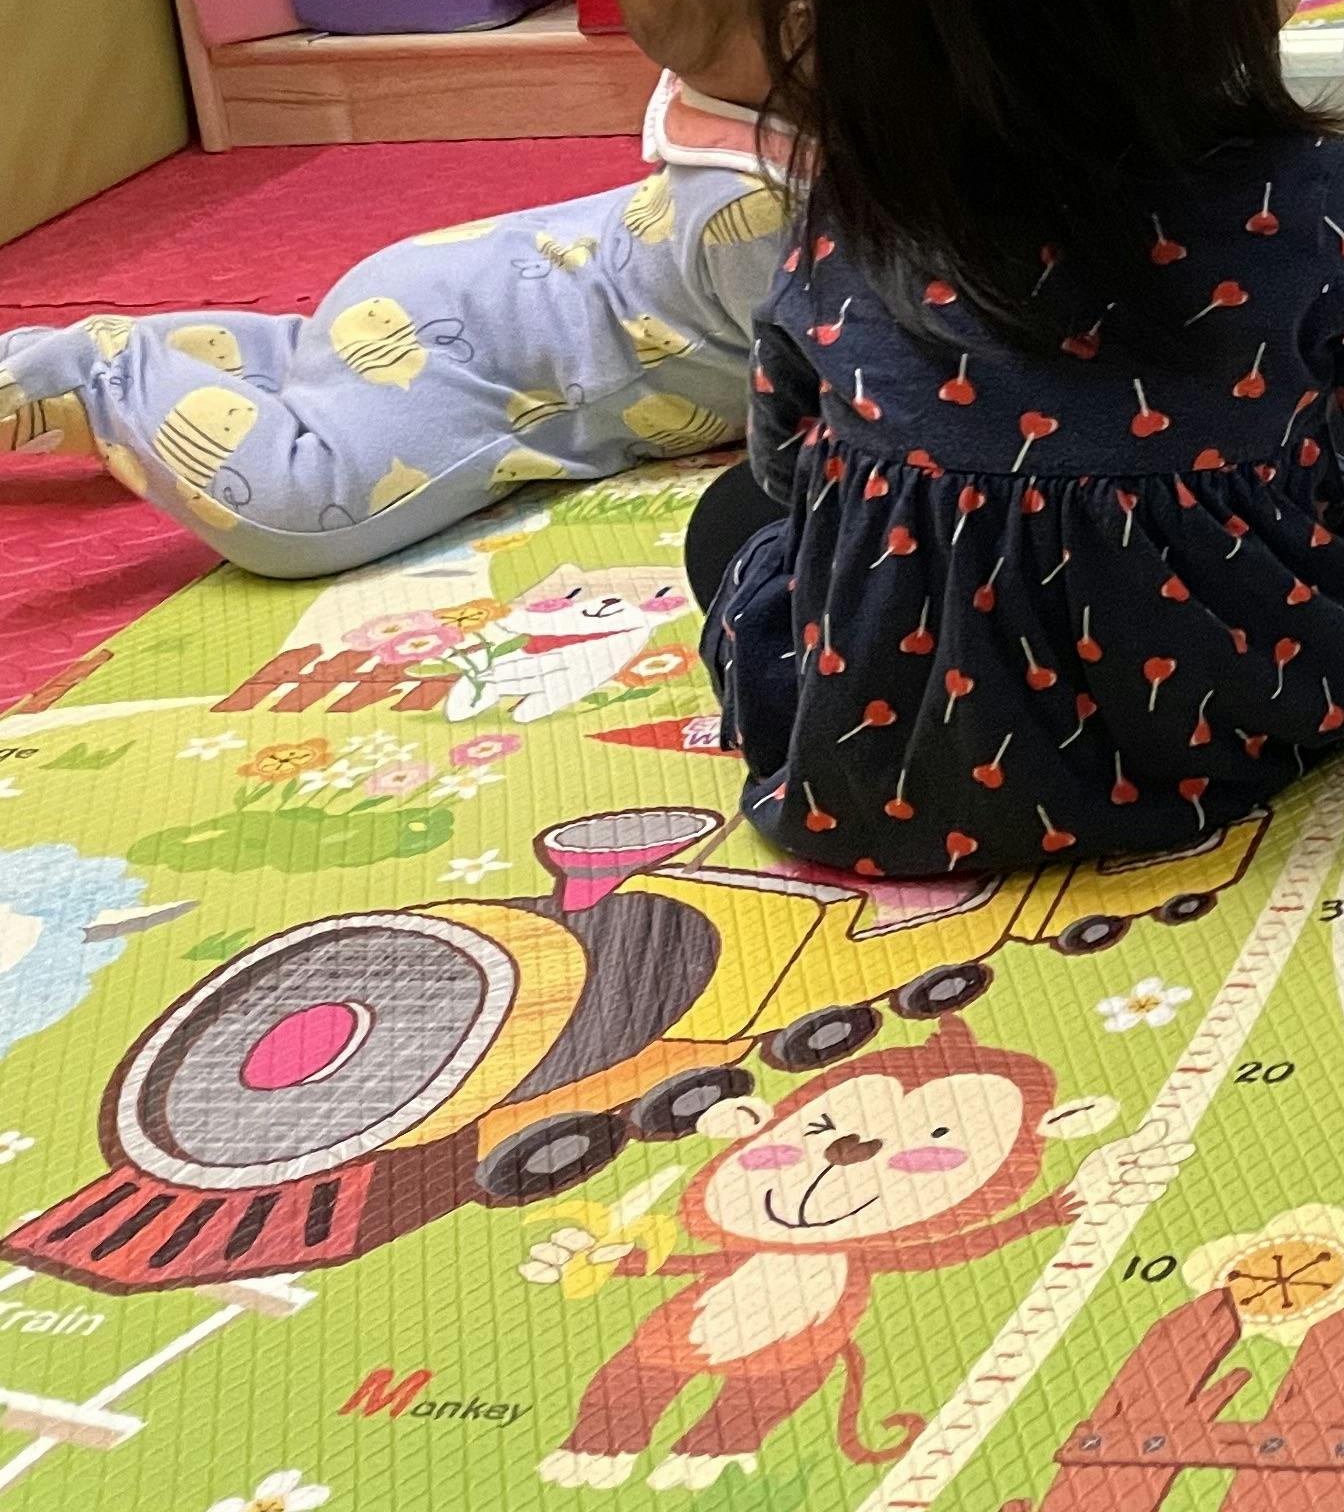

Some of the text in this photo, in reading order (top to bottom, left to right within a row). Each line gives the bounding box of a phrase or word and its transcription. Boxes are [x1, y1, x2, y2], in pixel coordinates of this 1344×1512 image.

[1234, 1061, 1296, 1085] 20
[1122, 1255, 1177, 1283] 10
[337, 1367, 534, 1428] Monkey
